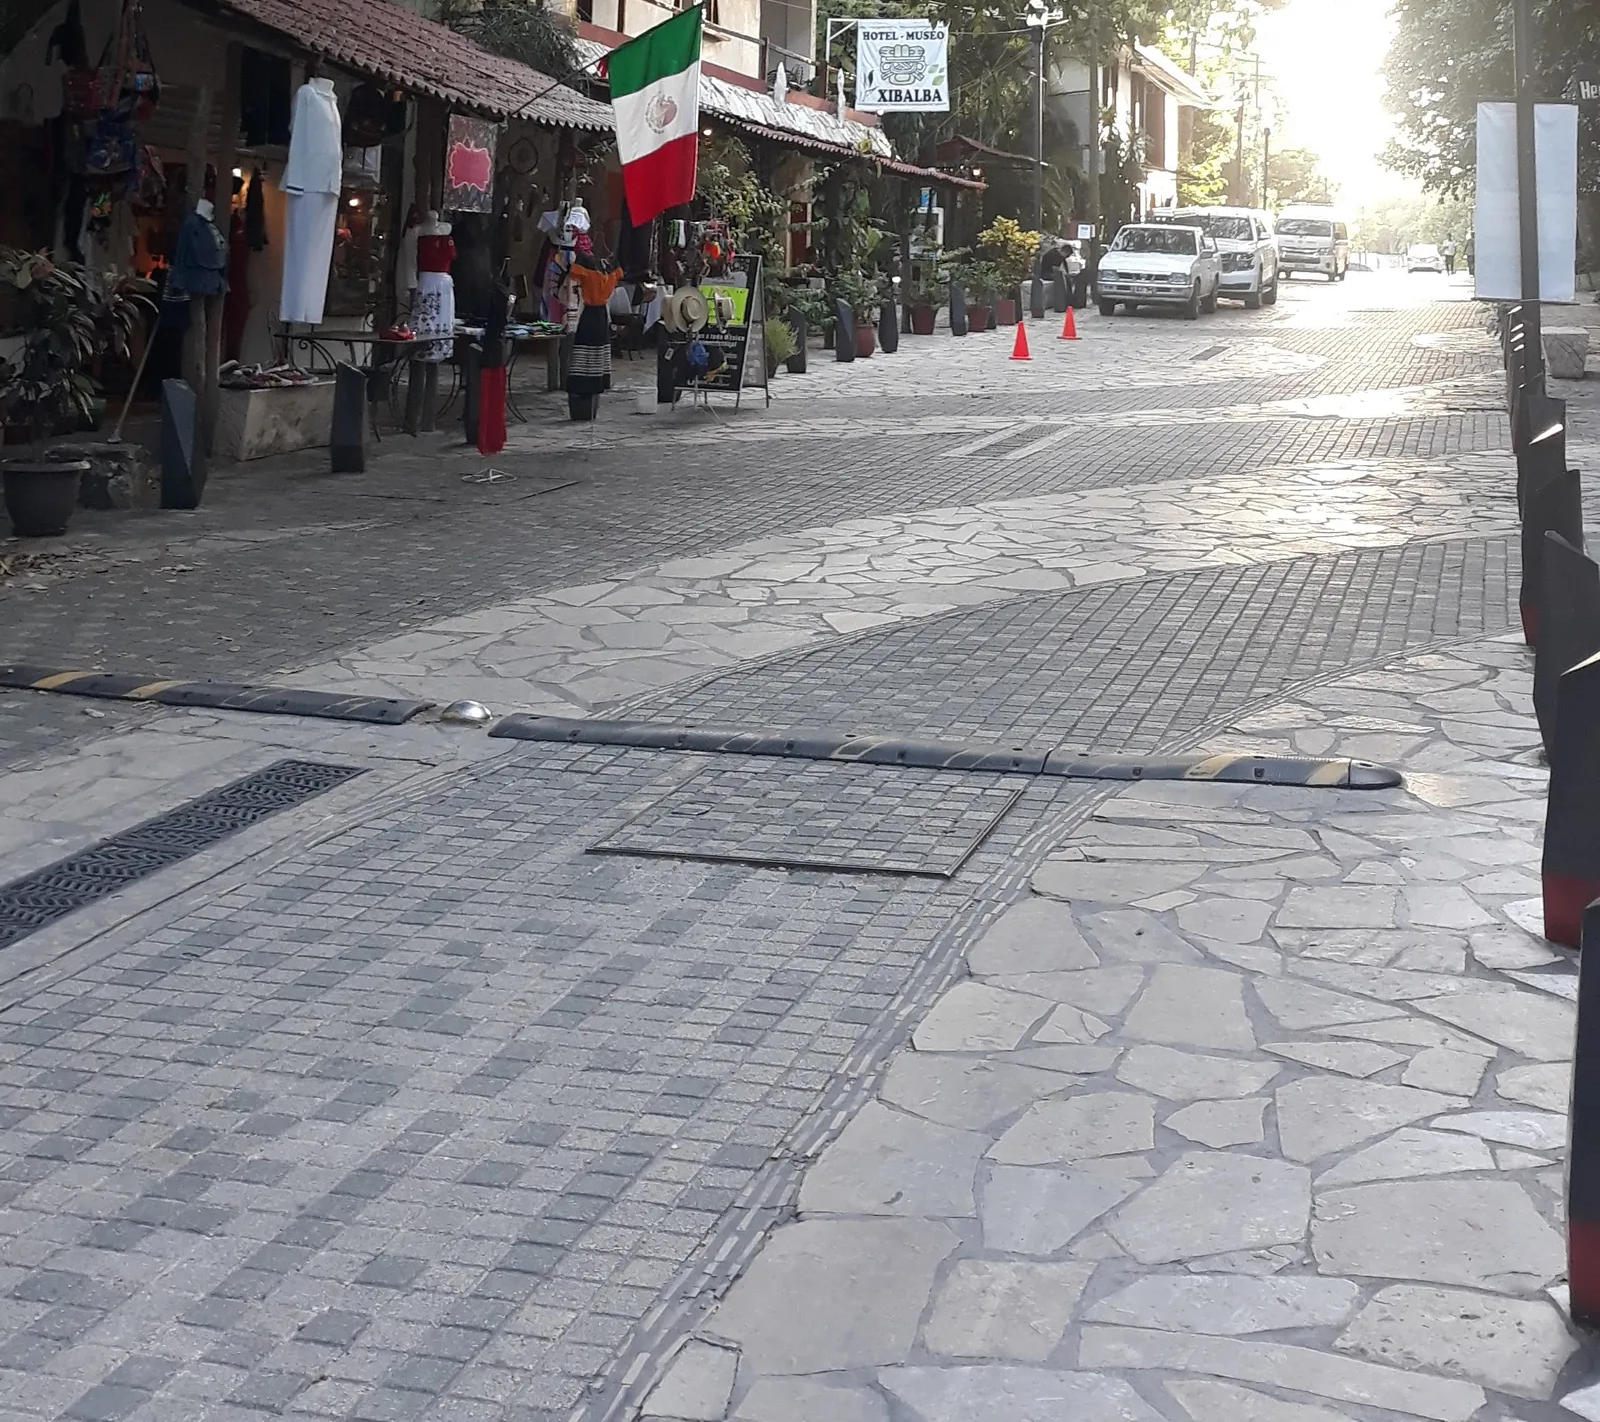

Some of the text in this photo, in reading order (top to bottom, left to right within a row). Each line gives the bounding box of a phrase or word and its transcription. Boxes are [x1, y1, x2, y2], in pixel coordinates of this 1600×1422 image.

[863, 31, 899, 40] HOTEL
[906, 31, 945, 40] MUSEO
[877, 89, 942, 102] XIBALBA
[1580, 80, 1600, 99] He
